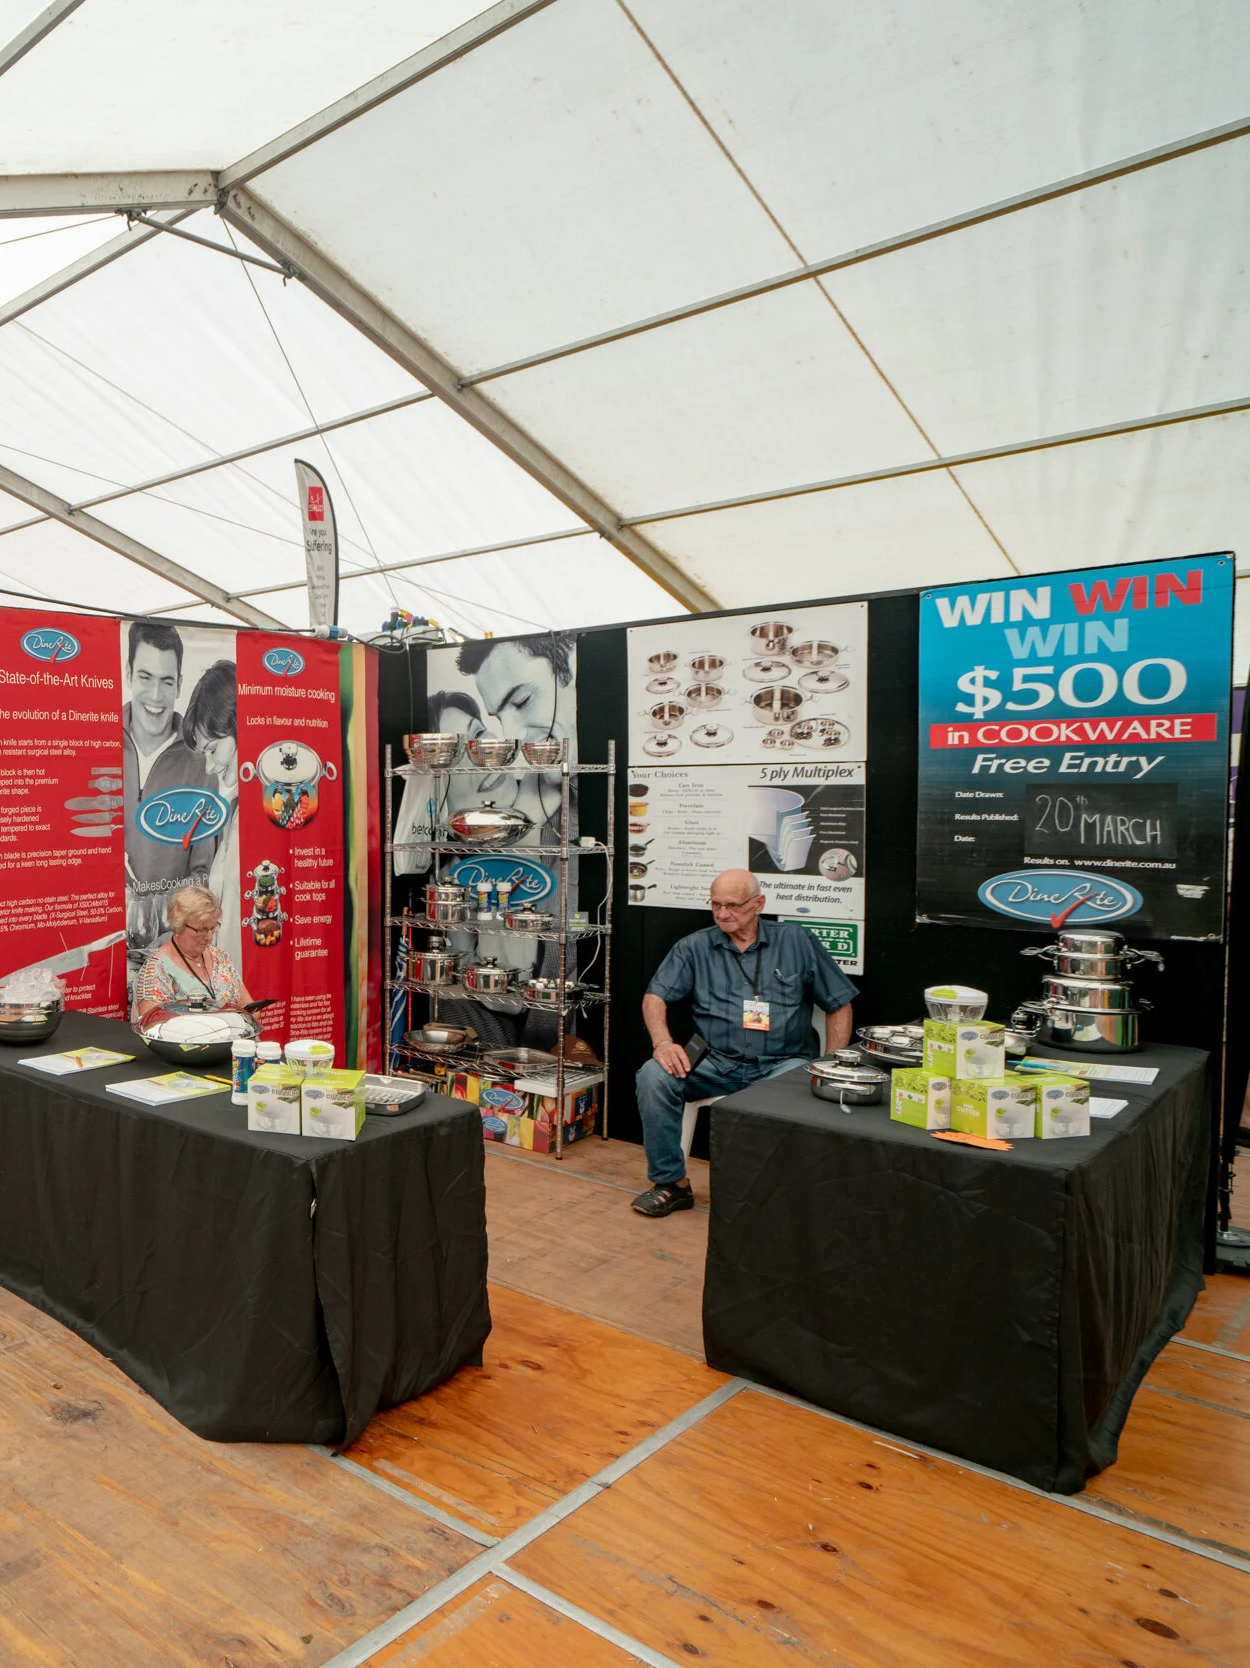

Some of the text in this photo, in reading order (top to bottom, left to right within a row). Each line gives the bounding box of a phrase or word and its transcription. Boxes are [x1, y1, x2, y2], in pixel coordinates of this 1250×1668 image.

[306, 539, 332, 555] Suffering
[935, 569, 1203, 629] WIN WIN
[1003, 618, 1129, 660] WIN
[81, 674, 114, 689] Knives
[238, 683, 335, 703] Minimum moisture cooking
[954, 657, 1188, 720] $500
[12, 709, 49, 720] evolution
[51, 709, 59, 720] of
[61, 712, 67, 720] a
[69, 710, 99, 721] Dinerite
[100, 711, 119, 722] knife
[246, 715, 328, 728] Locks in flavour and nutrition
[947, 718, 1193, 745] in COOKWARE
[3, 738, 17, 746] knife
[34, 738, 47, 746] from
[52, 739, 68, 748] single
[68, 739, 83, 747] block
[84, 739, 90, 747] of
[90, 740, 102, 749] high
[2, 748, 26, 756] resistant
[27, 748, 48, 757] surgical
[49, 748, 62, 756] steel
[971, 749, 1166, 779] Free Entry
[631, 770, 688, 779] Your Choices
[759, 765, 854, 781] 5 ply Multiplex
[34, 778, 58, 786] premium
[0, 806, 19, 815] forged
[20, 806, 36, 814] piece
[13, 815, 39, 823] hardened
[954, 813, 1018, 821] Results Published:
[1, 824, 27, 834] tempered
[1080, 813, 1161, 845] MARCH
[954, 834, 975, 842] Date:
[3, 851, 20, 860] blade
[21, 851, 26, 859] is
[27, 849, 52, 859] precision
[53, 849, 67, 858] taper
[68, 848, 87, 857] ground
[98, 846, 111, 854] hand
[294, 846, 313, 856] Invest
[314, 846, 320, 855] in
[7, 861, 15, 869] for
[21, 860, 35, 868] keen
[35, 859, 48, 868] long
[49, 858, 66, 867] lasting
[294, 858, 333, 868] healthy future
[1023, 856, 1054, 865] Results
[1074, 858, 1176, 869] www.dinerite.com.au
[294, 880, 321, 890] Suitable
[321, 880, 329, 889] for
[759, 880, 772, 889] The
[774, 881, 805, 891] ultimate
[807, 883, 814, 891] in
[816, 883, 831, 893] fast
[295, 893, 326, 903] cook tops
[776, 893, 843, 904] heat distribution.
[294, 915, 333, 925] Save energy
[811, 928, 849, 938] RTER
[294, 937, 321, 947] Lifetime
[294, 949, 328, 961] guarantee
